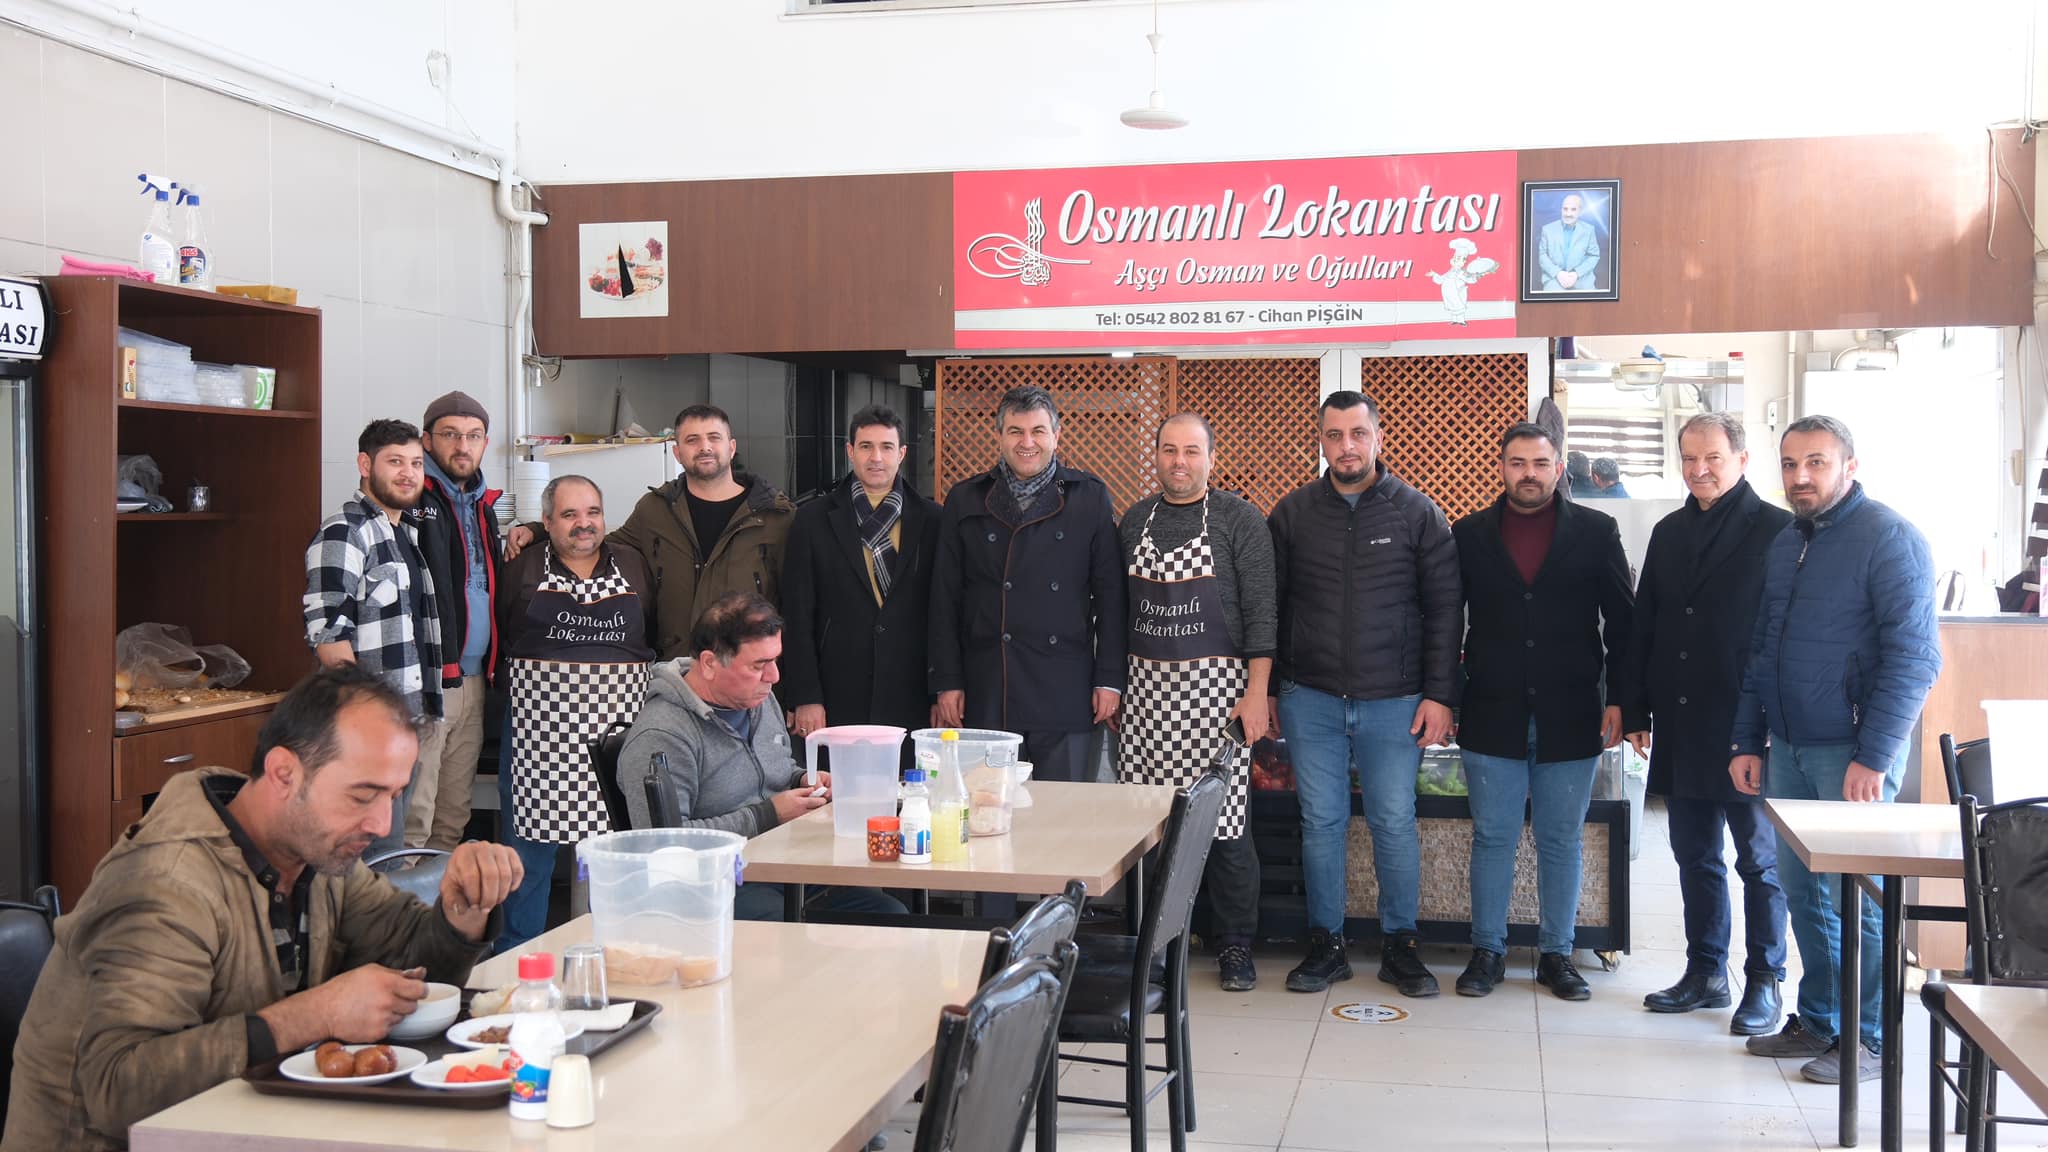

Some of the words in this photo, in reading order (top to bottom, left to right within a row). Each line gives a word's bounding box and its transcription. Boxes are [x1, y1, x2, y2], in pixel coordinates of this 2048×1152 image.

[1058, 189, 1245, 246] Osmanlı
[1258, 183, 1501, 239] Lokantası
[1114, 258, 1169, 292] Aşçı
[1175, 257, 1266, 286] Osman
[1272, 262, 1300, 283] ve
[1305, 253, 1413, 289] Oğulları
[1096, 313, 1121, 326] Tel:
[1125, 312, 1166, 325] 0542
[1170, 311, 1200, 324] 802
[1203, 311, 1222, 324] 81
[1225, 310, 1245, 323] 67
[1258, 308, 1303, 323] Cihan
[1307, 303, 1363, 324] PİŞĞİN
[1140, 596, 1200, 617] Osmanlı
[1134, 617, 1206, 637] Lokantası
